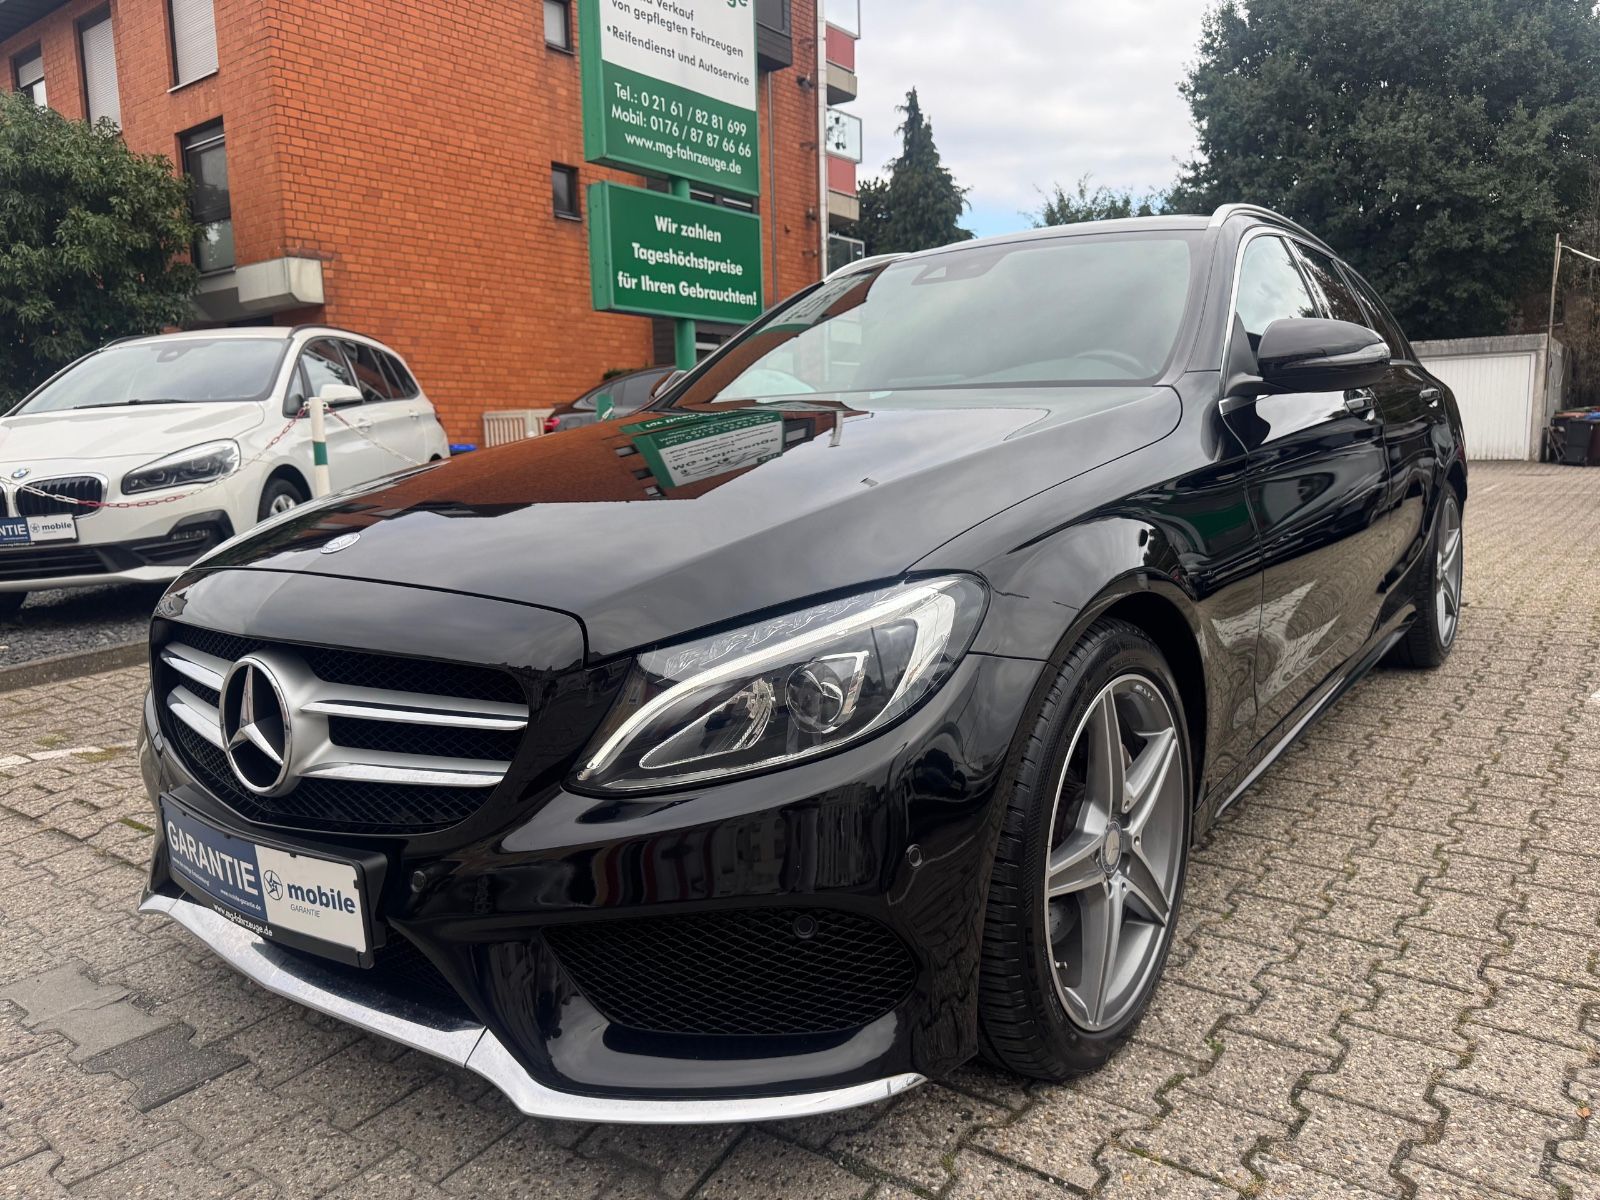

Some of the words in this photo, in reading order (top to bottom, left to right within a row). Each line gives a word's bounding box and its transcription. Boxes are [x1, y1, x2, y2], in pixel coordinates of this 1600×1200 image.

[657, 0, 694, 21] Verkauf
[633, 8, 688, 36] gepflegten
[691, 27, 744, 57] Fahrzeugen
[612, 25, 675, 59] Reifendienst
[678, 51, 696, 66] und
[698, 58, 750, 86] Autoservice
[614, 82, 638, 104] Tel.:
[641, 92, 649, 107] 0
[652, 95, 666, 112] 21
[670, 101, 683, 118] 61
[695, 109, 708, 125] 82
[711, 114, 723, 130] 81
[727, 119, 747, 137] 699
[611, 104, 647, 127] Mobil:
[650, 116, 679, 137] 0176
[690, 128, 703, 144] 87
[706, 133, 719, 148] 87
[722, 139, 735, 154] 66
[738, 143, 751, 158] 66
[625, 133, 742, 175] www.mg-fahrzeuge.de
[654, 215, 678, 235] Wir
[680, 223, 722, 243] zahlen
[632, 242, 743, 276] Tageshöchstpreise
[617, 271, 638, 290] für
[641, 275, 676, 295] Ihren
[679, 281, 757, 306] Gebrauchten!
[0, 524, 27, 535] NTIE
[42, 522, 72, 530] mobile
[167, 819, 259, 896] GARANTIE
[287, 883, 356, 914] mobile
[290, 904, 320, 918] GARANTIE
